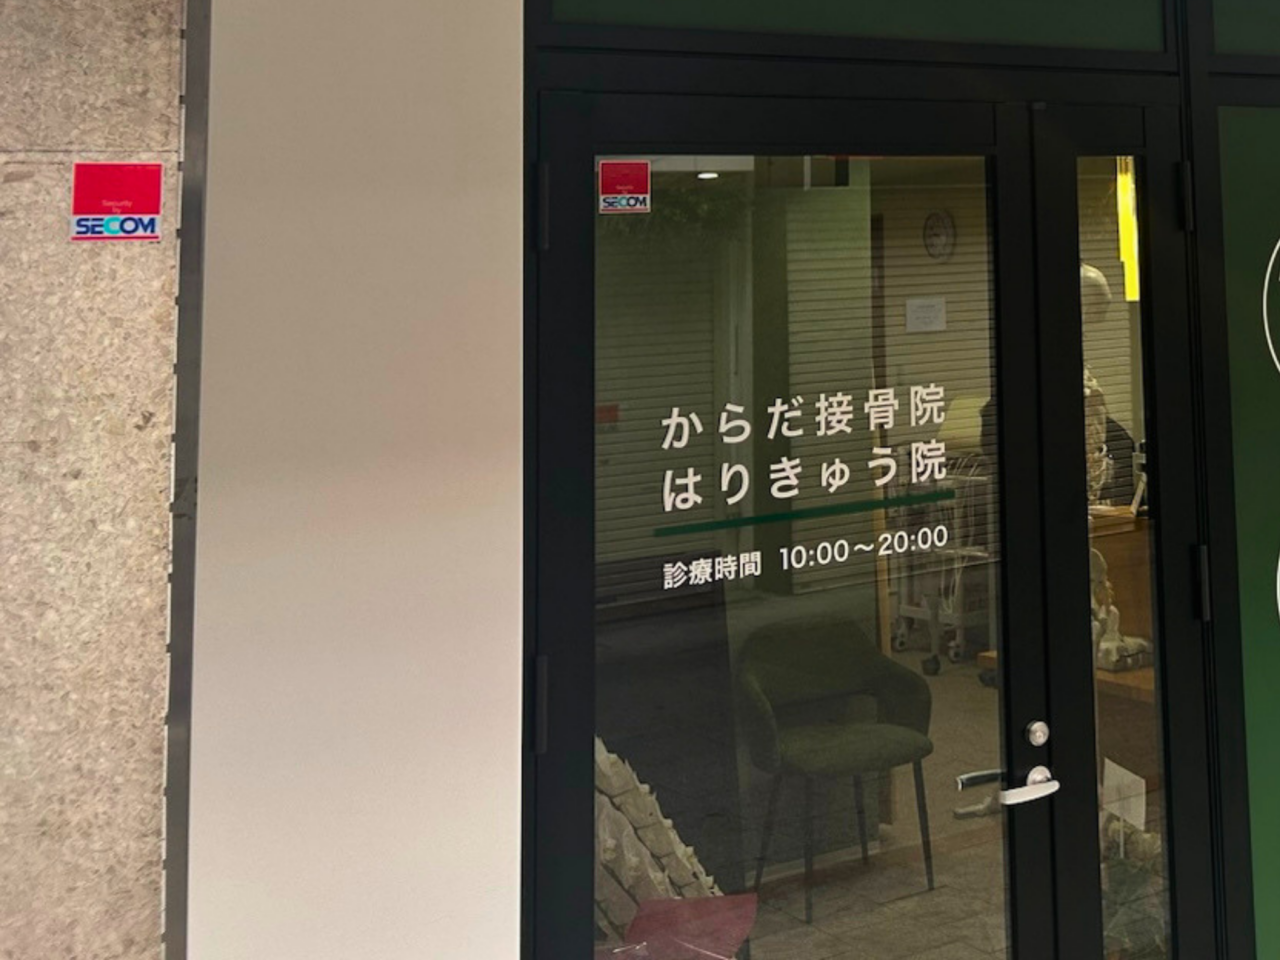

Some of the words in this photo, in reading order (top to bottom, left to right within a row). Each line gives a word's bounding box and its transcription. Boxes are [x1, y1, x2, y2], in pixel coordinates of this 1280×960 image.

[602, 196, 647, 208] SECOM
[76, 216, 156, 235] SECOM
[660, 383, 946, 452] からだ接骨院
[661, 439, 948, 512] はりきゅう院
[662, 551, 762, 590] 診療時間
